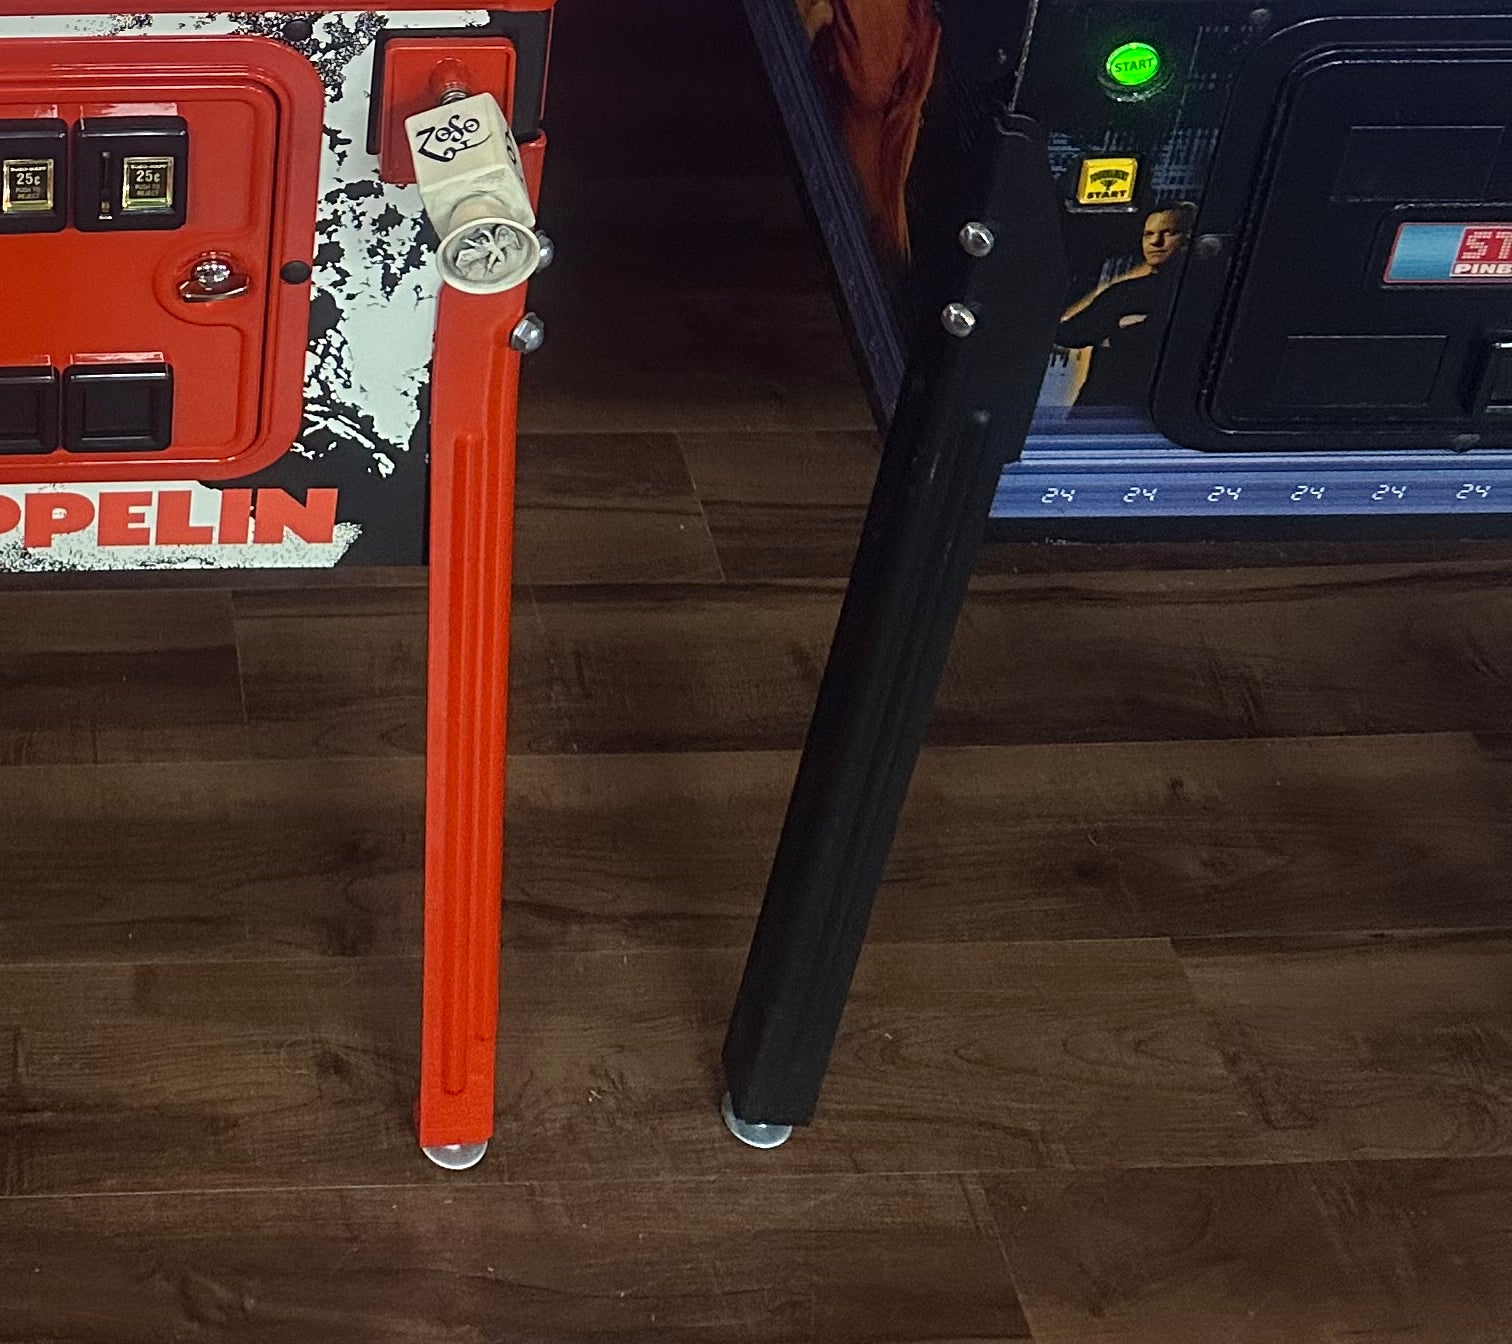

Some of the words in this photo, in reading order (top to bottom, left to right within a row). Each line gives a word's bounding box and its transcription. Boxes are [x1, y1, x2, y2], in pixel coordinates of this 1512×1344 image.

[1114, 56, 1155, 73] START
[1086, 189, 1128, 200] START
[1040, 487, 1076, 504] 24
[1122, 487, 1158, 503] 24
[1207, 486, 1242, 502] 24
[1290, 485, 1326, 501] 24
[1370, 484, 1407, 500] 24
[1455, 483, 1491, 500] 24
